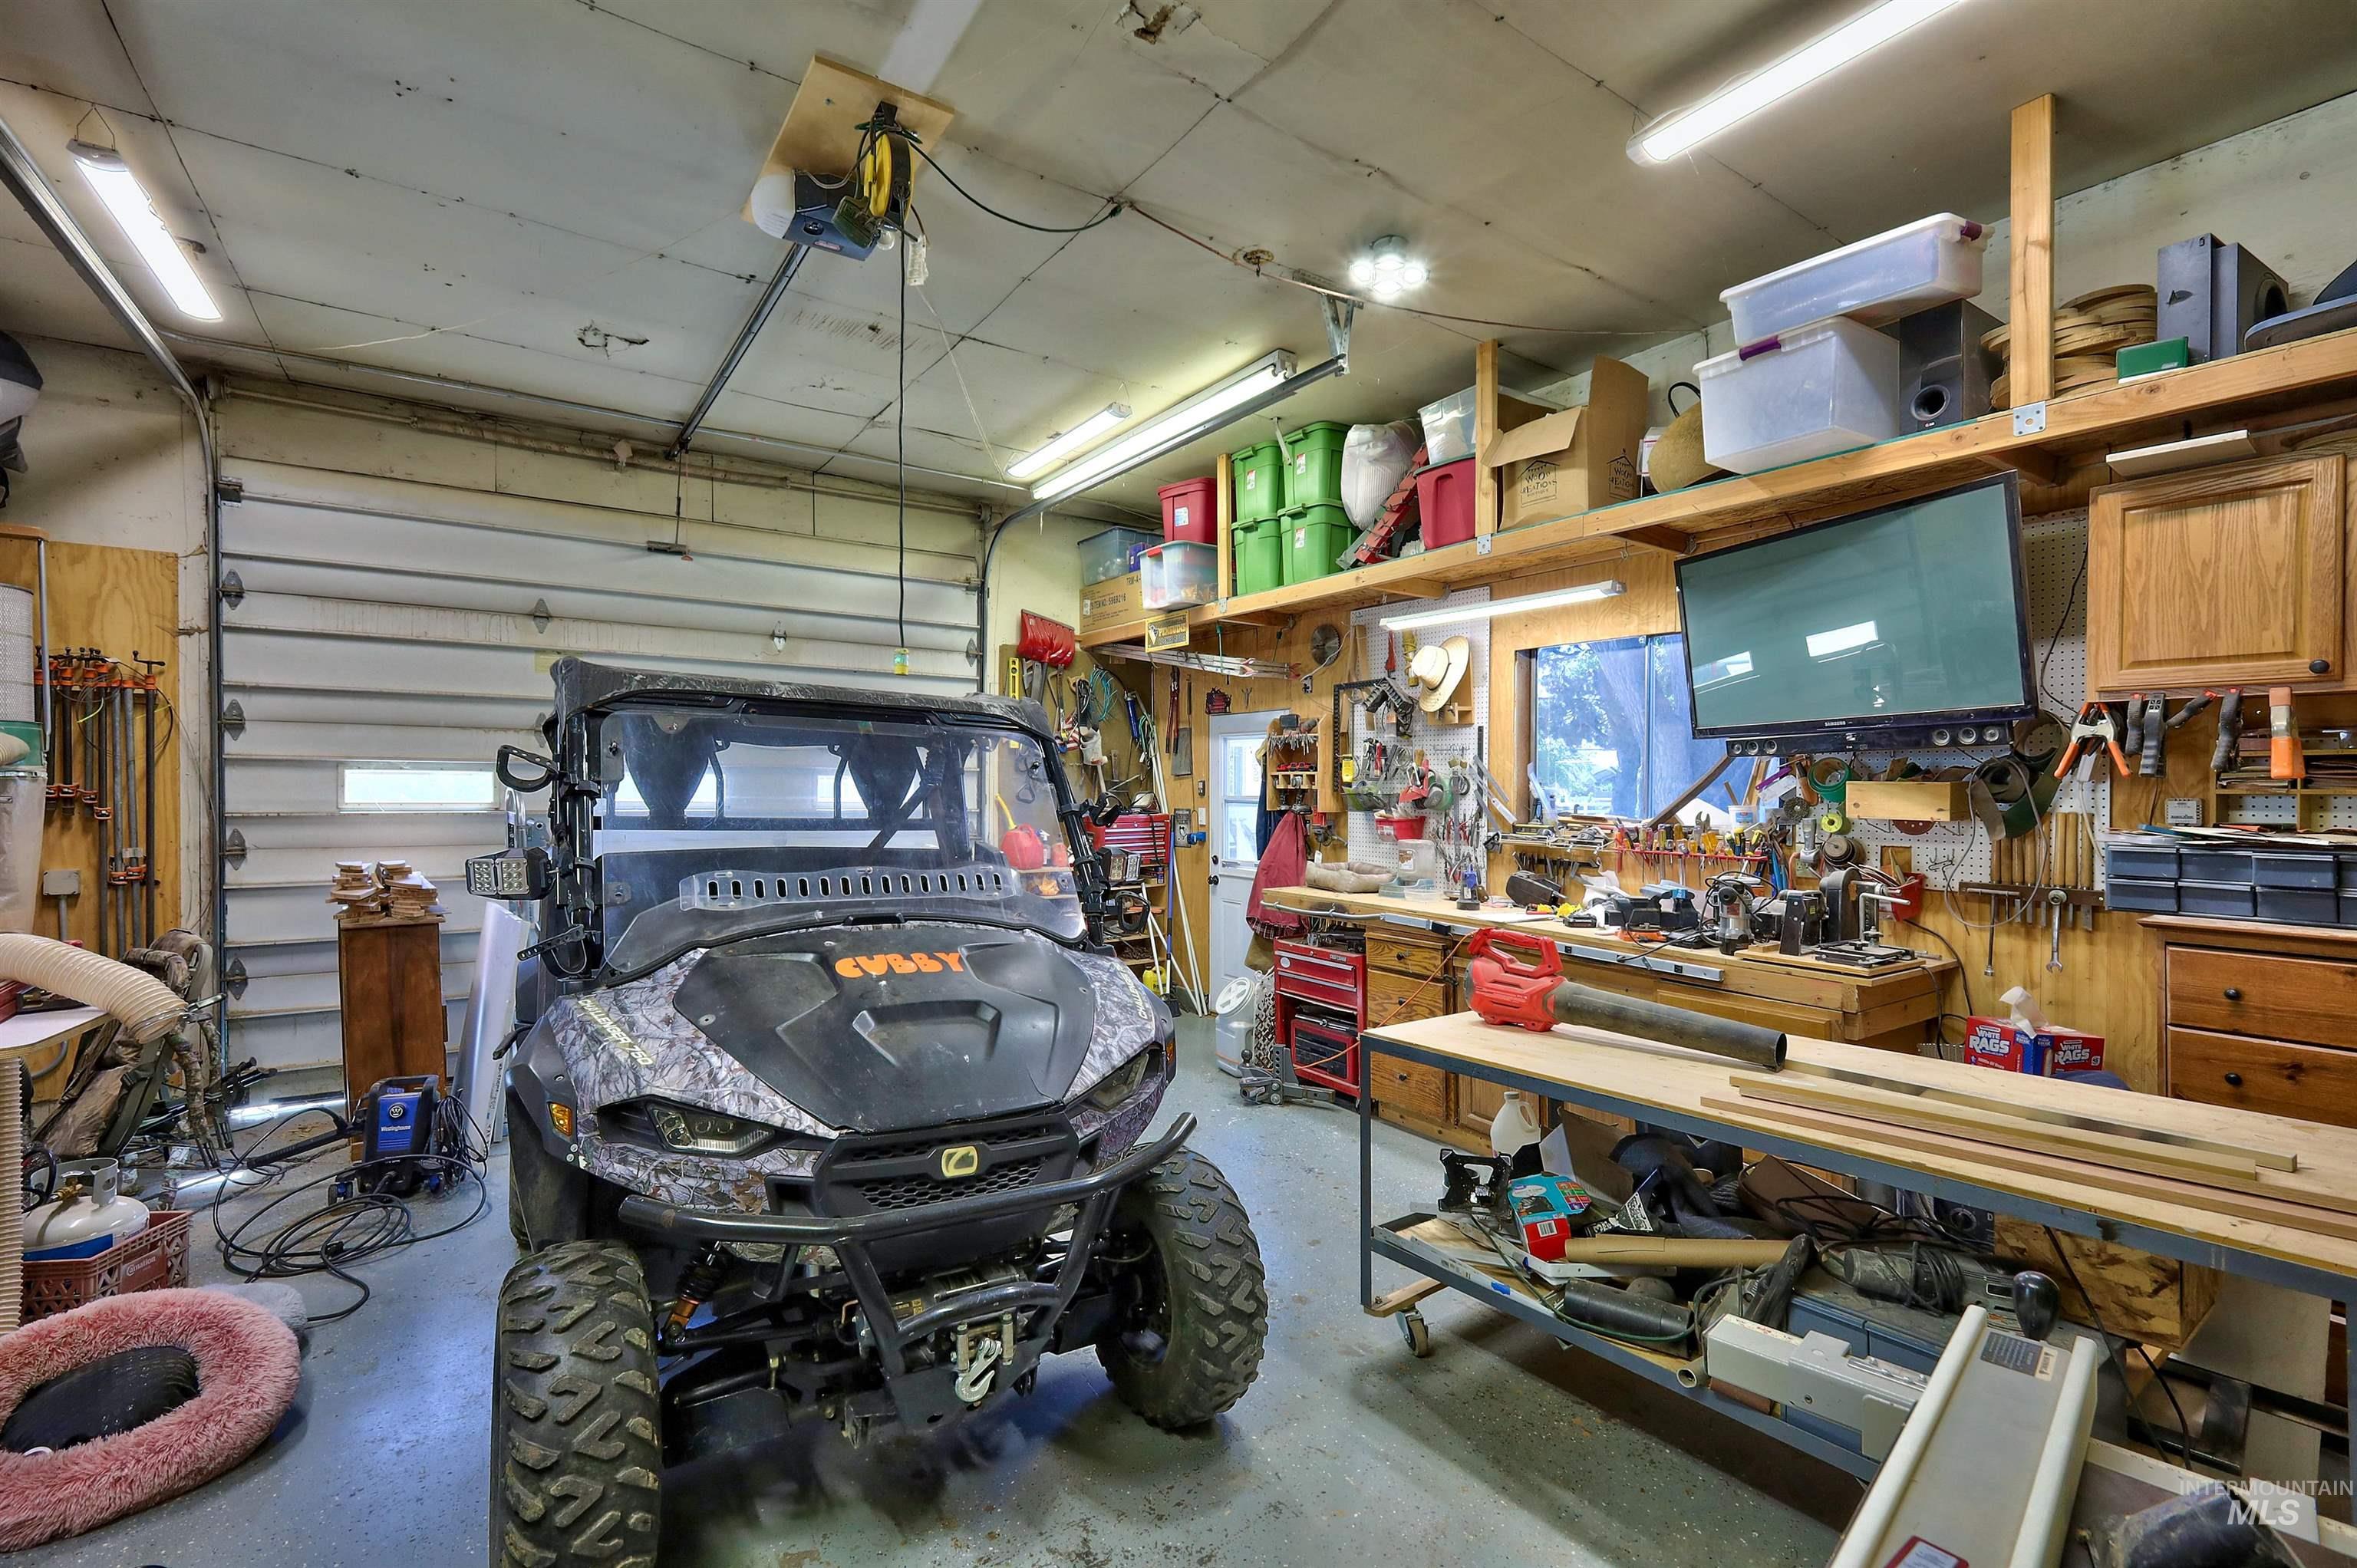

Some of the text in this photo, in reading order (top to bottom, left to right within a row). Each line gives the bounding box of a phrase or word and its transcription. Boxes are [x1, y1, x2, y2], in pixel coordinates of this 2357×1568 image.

[835, 953, 964, 979] CUBBY
[578, 999, 654, 1066] CHALLENGER 750
[1976, 1026, 2000, 1039] WHITE
[1969, 1035, 2010, 1054] RAGS
[2054, 1049, 2090, 1065] RAGS
